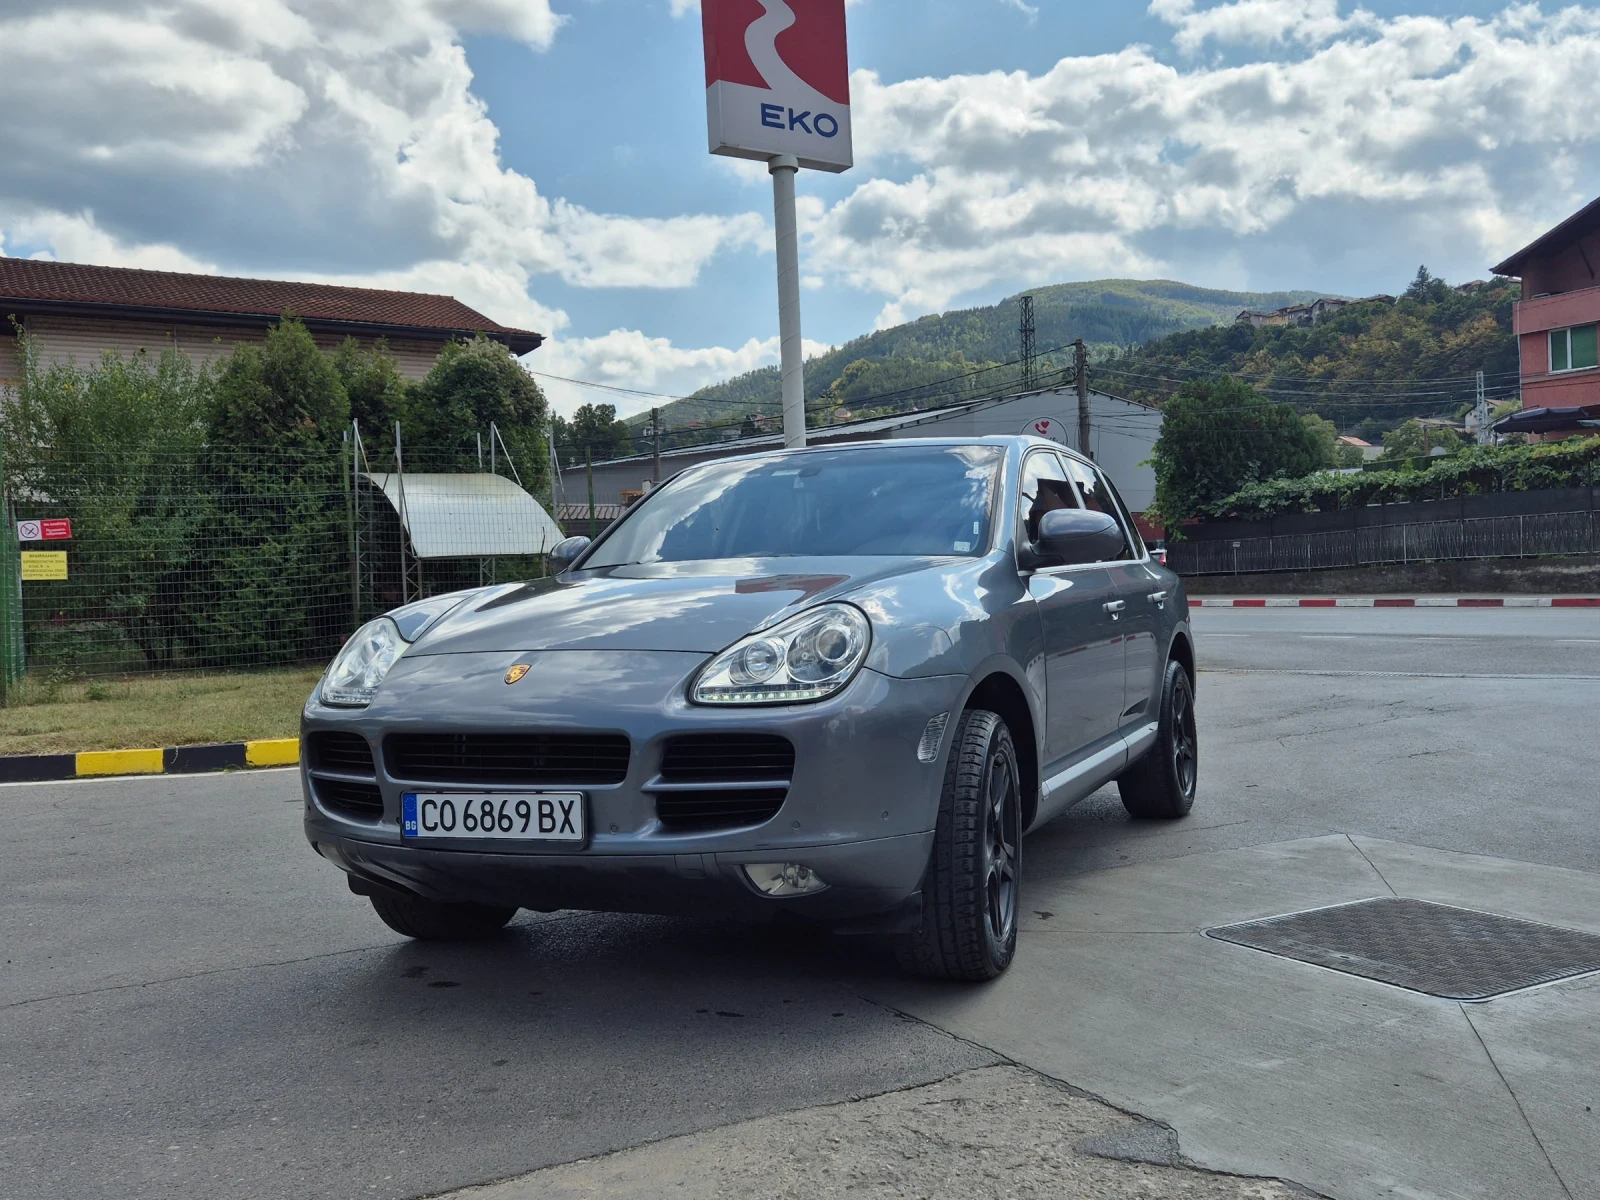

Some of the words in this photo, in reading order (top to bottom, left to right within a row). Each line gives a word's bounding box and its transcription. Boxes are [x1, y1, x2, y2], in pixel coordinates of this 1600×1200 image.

[760, 102, 839, 138] EKO
[405, 820, 417, 831] BG
[462, 799, 532, 833] 6869
